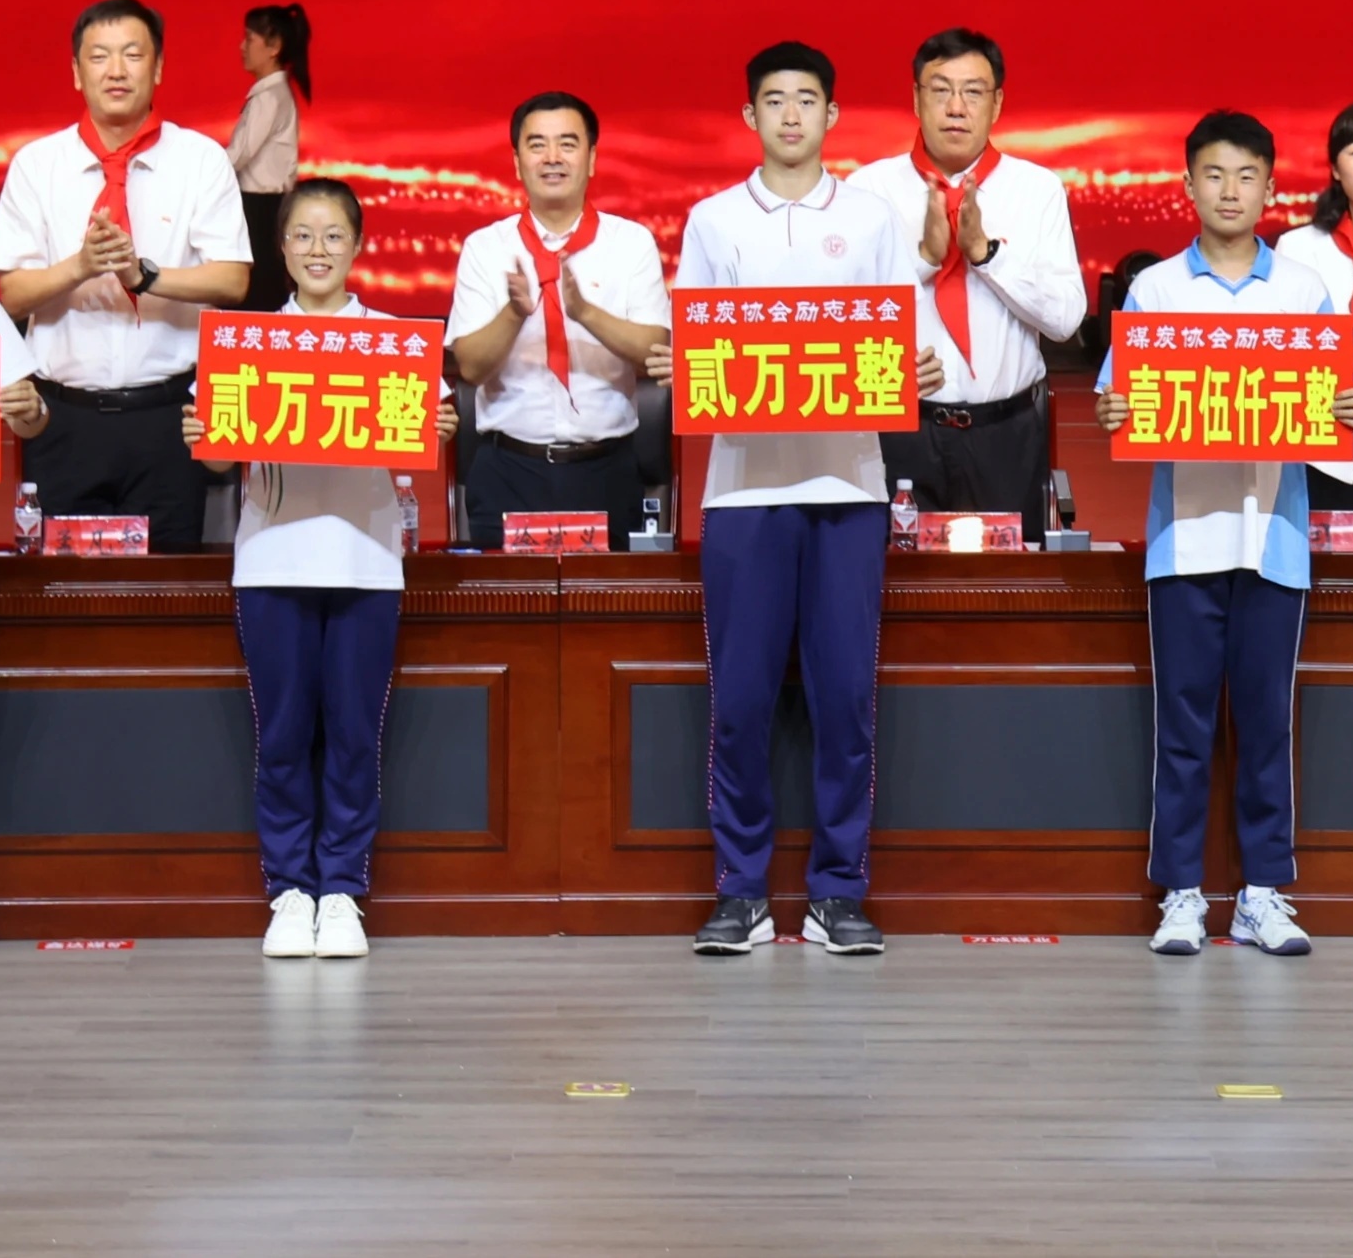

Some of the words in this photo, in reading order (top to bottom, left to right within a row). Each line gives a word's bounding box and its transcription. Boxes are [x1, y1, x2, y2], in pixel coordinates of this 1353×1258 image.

[685, 297, 902, 325] 煤炭协会励志基金
[1125, 324, 1342, 351] 煤炭协会励志基金
[212, 325, 429, 358] 煤炭协会励志基金
[684, 336, 906, 419] 贰万元整
[1127, 363, 1339, 447] 壹万伍仟元整
[207, 363, 429, 453] 贰万元整
